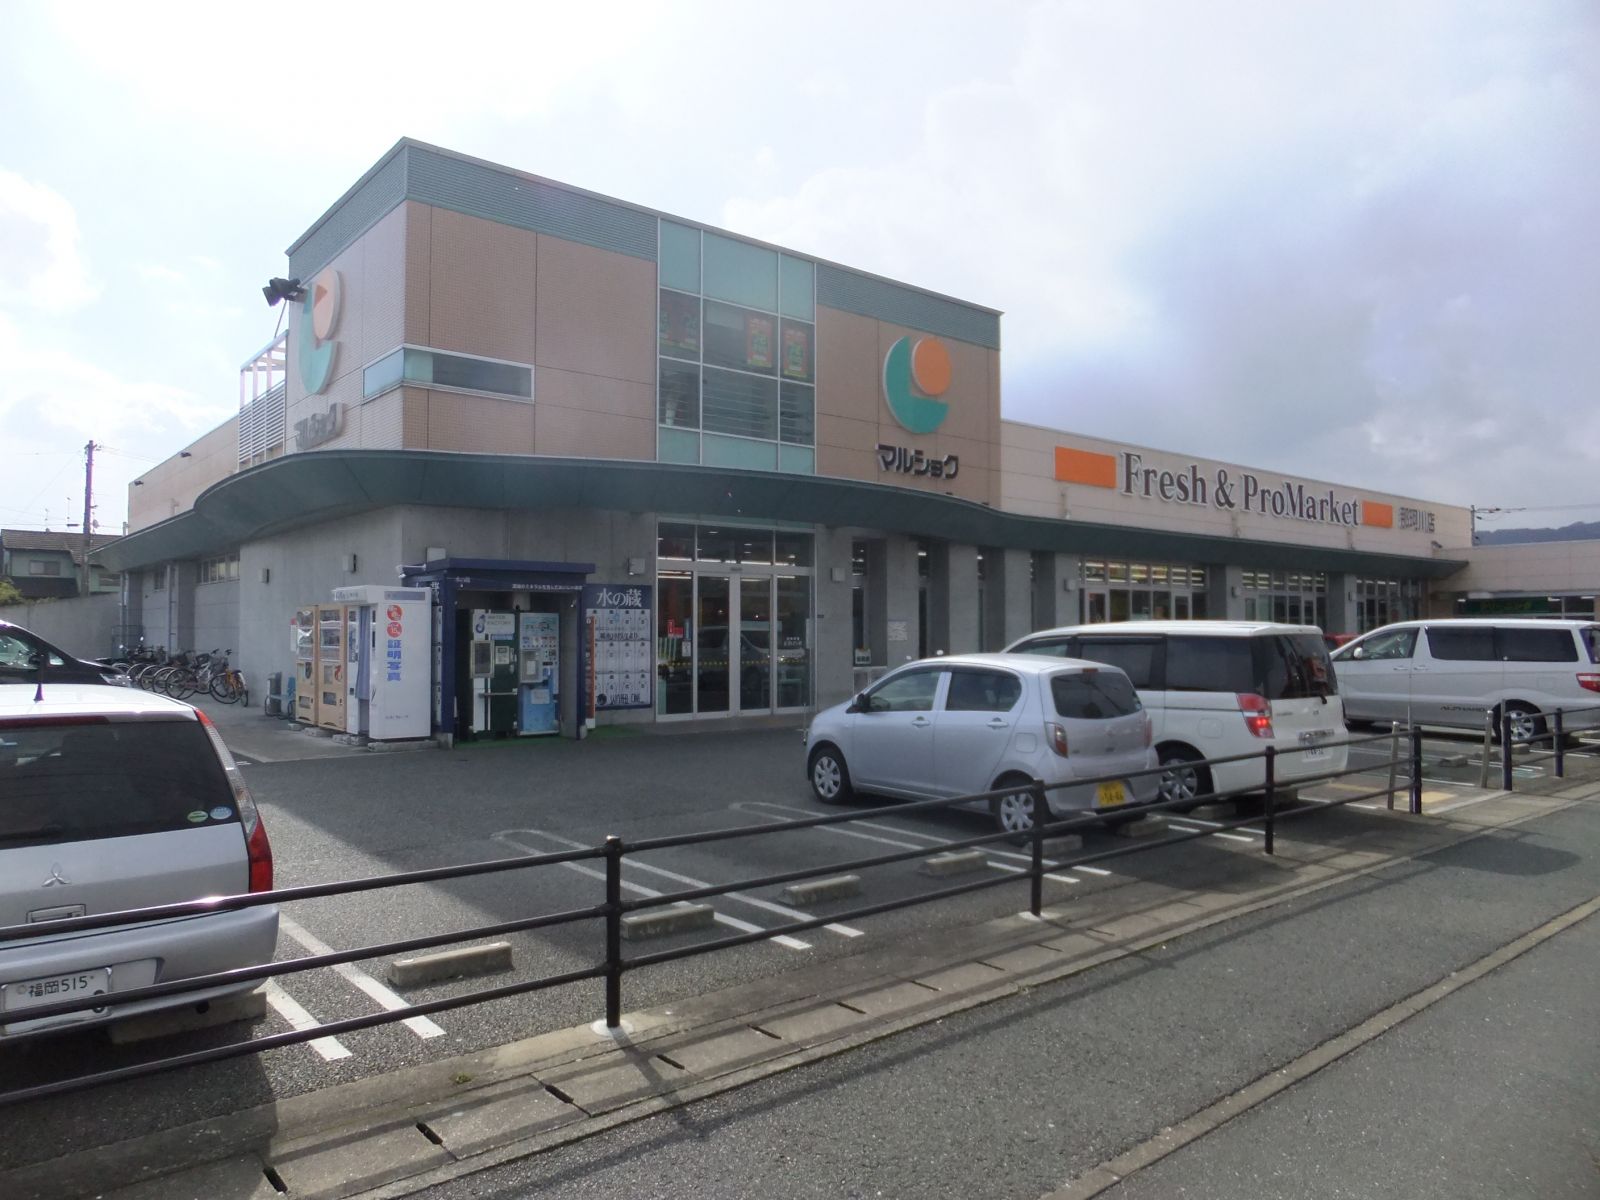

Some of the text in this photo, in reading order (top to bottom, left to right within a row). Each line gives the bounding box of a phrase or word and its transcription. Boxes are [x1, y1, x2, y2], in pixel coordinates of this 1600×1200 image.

[875, 443, 959, 479] マルショク
[1119, 451, 1360, 527] Fresh & ProMarket
[596, 587, 643, 607] 水の蔵
[386, 639, 402, 682] 証明写真
